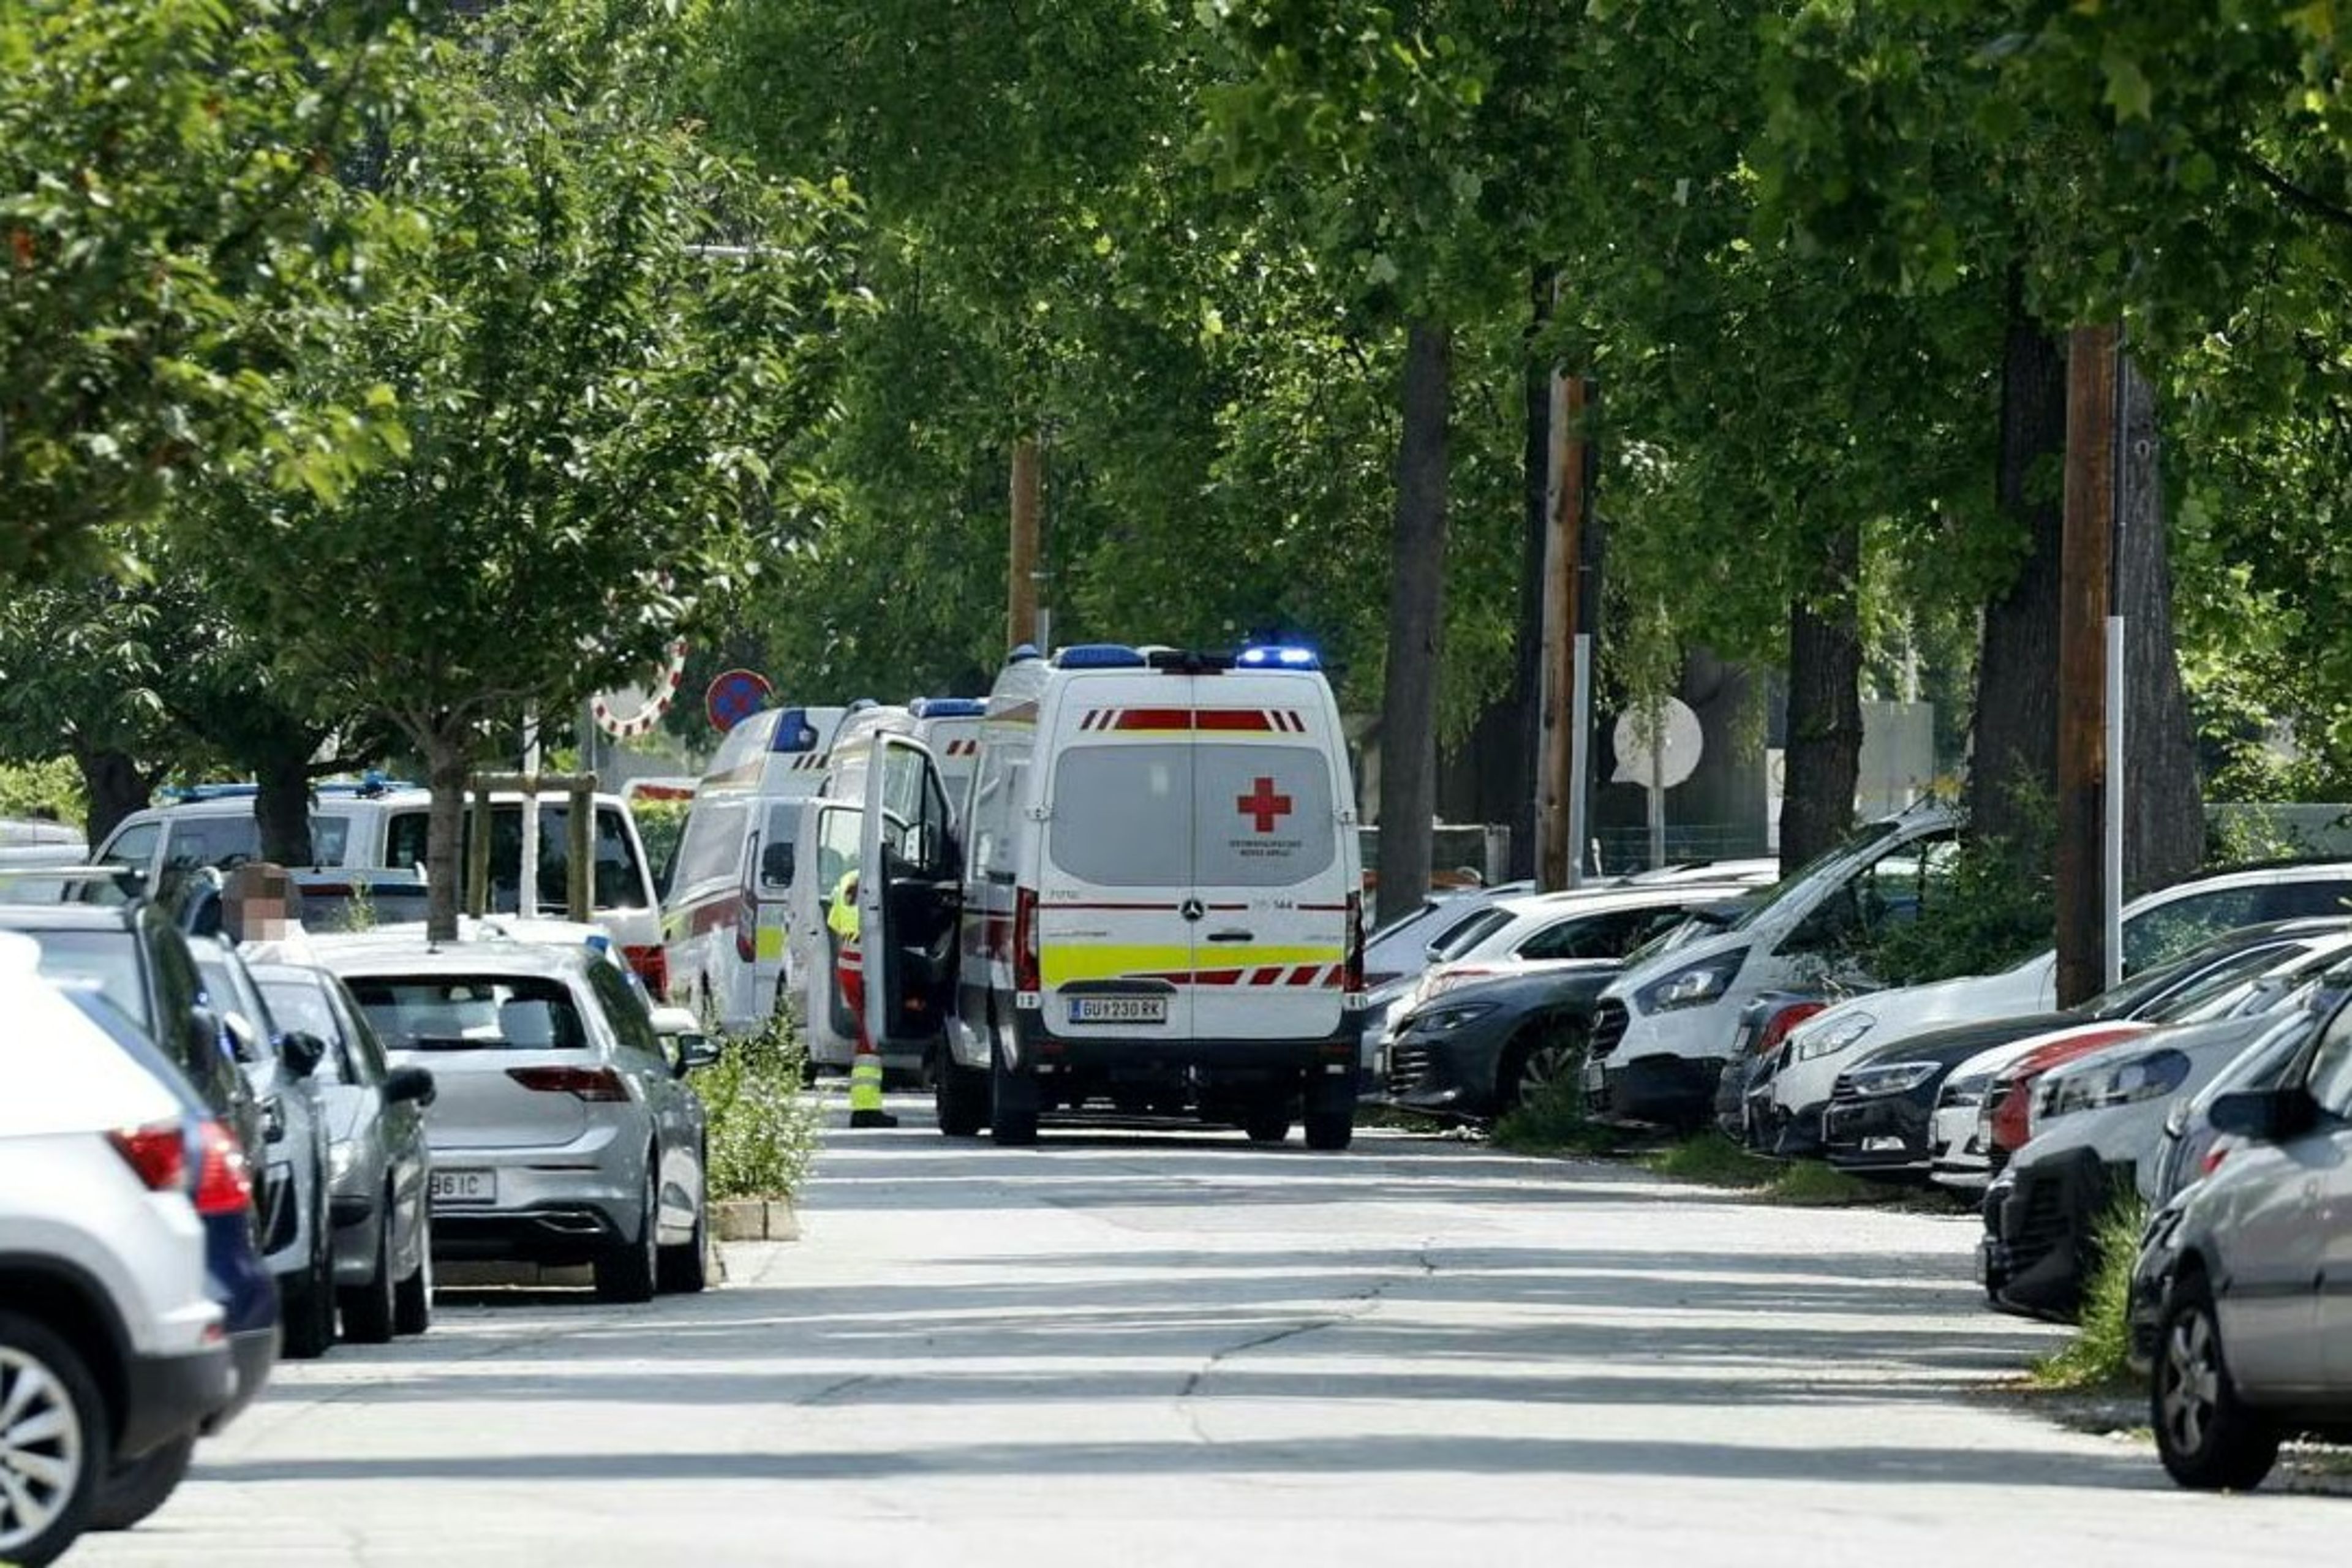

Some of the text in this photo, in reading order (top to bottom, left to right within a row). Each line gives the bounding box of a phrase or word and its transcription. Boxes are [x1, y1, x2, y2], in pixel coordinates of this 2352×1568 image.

[1084, 1000, 1159, 1017] GU 230 RK
